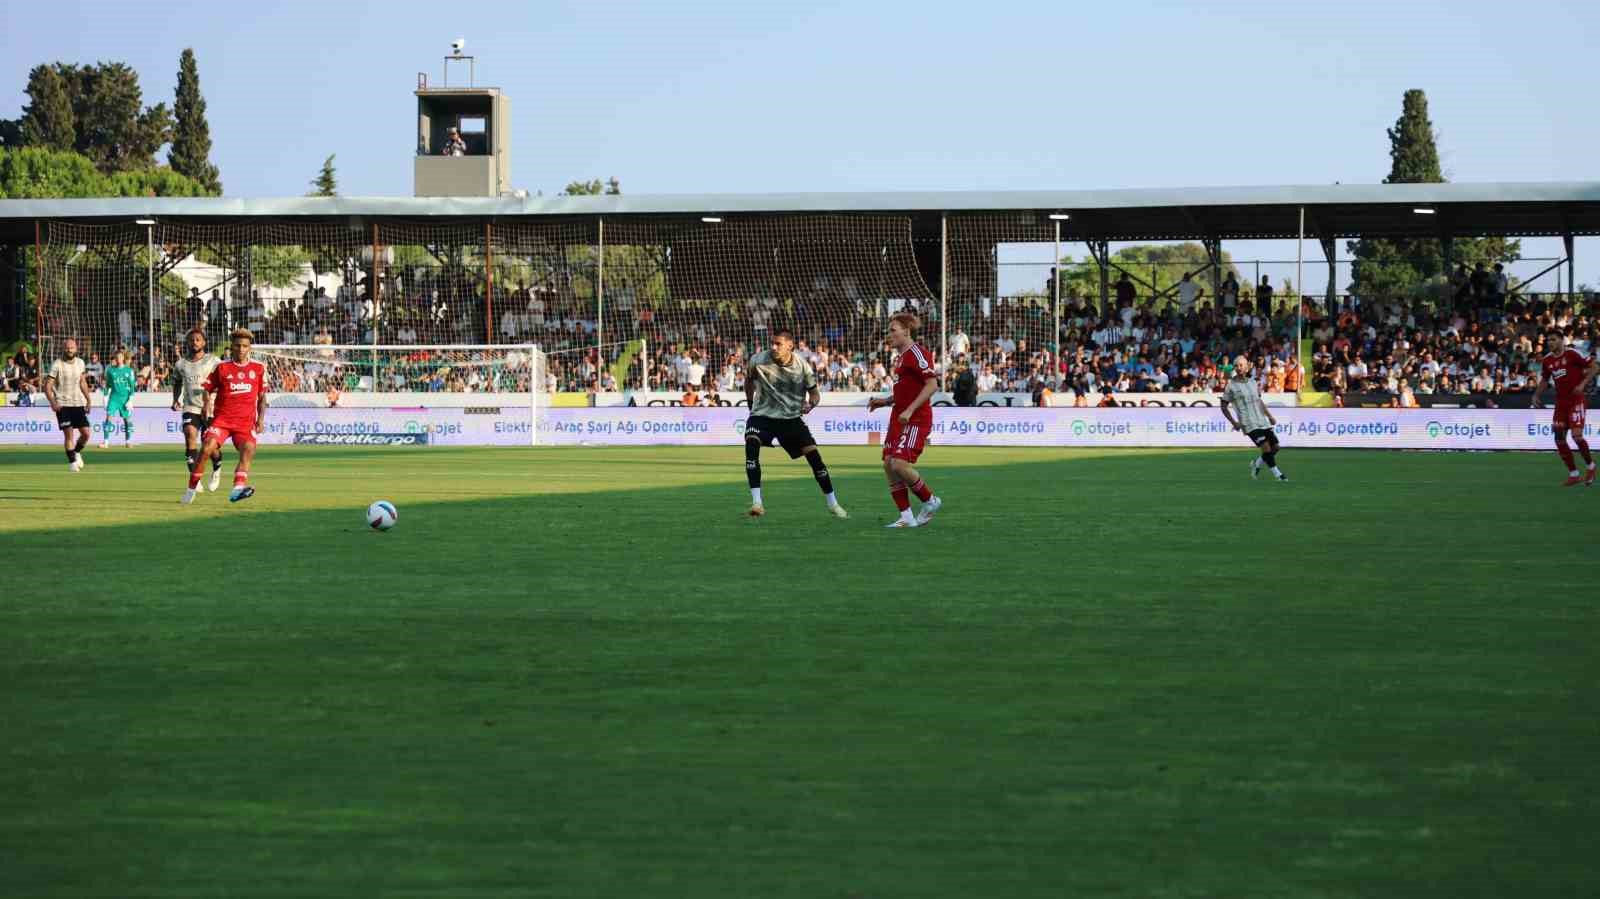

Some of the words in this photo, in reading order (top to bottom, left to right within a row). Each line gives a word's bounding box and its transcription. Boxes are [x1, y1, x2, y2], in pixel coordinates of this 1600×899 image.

[555, 420, 583, 434] Araç
[587, 420, 612, 434] Şarj
[616, 420, 638, 434] Ağı
[642, 420, 708, 433] Operatörü
[824, 419, 881, 432] Elektrikli
[950, 420, 972, 435] Ağı
[976, 420, 1044, 433] Operatörü
[1088, 421, 1131, 436] otojet
[1166, 421, 1226, 433] Elektrikli
[1297, 421, 1320, 436] Ağı
[1326, 421, 1398, 436] Operatörü
[1443, 422, 1490, 438] otojet
[898, 435, 907, 448] 2
